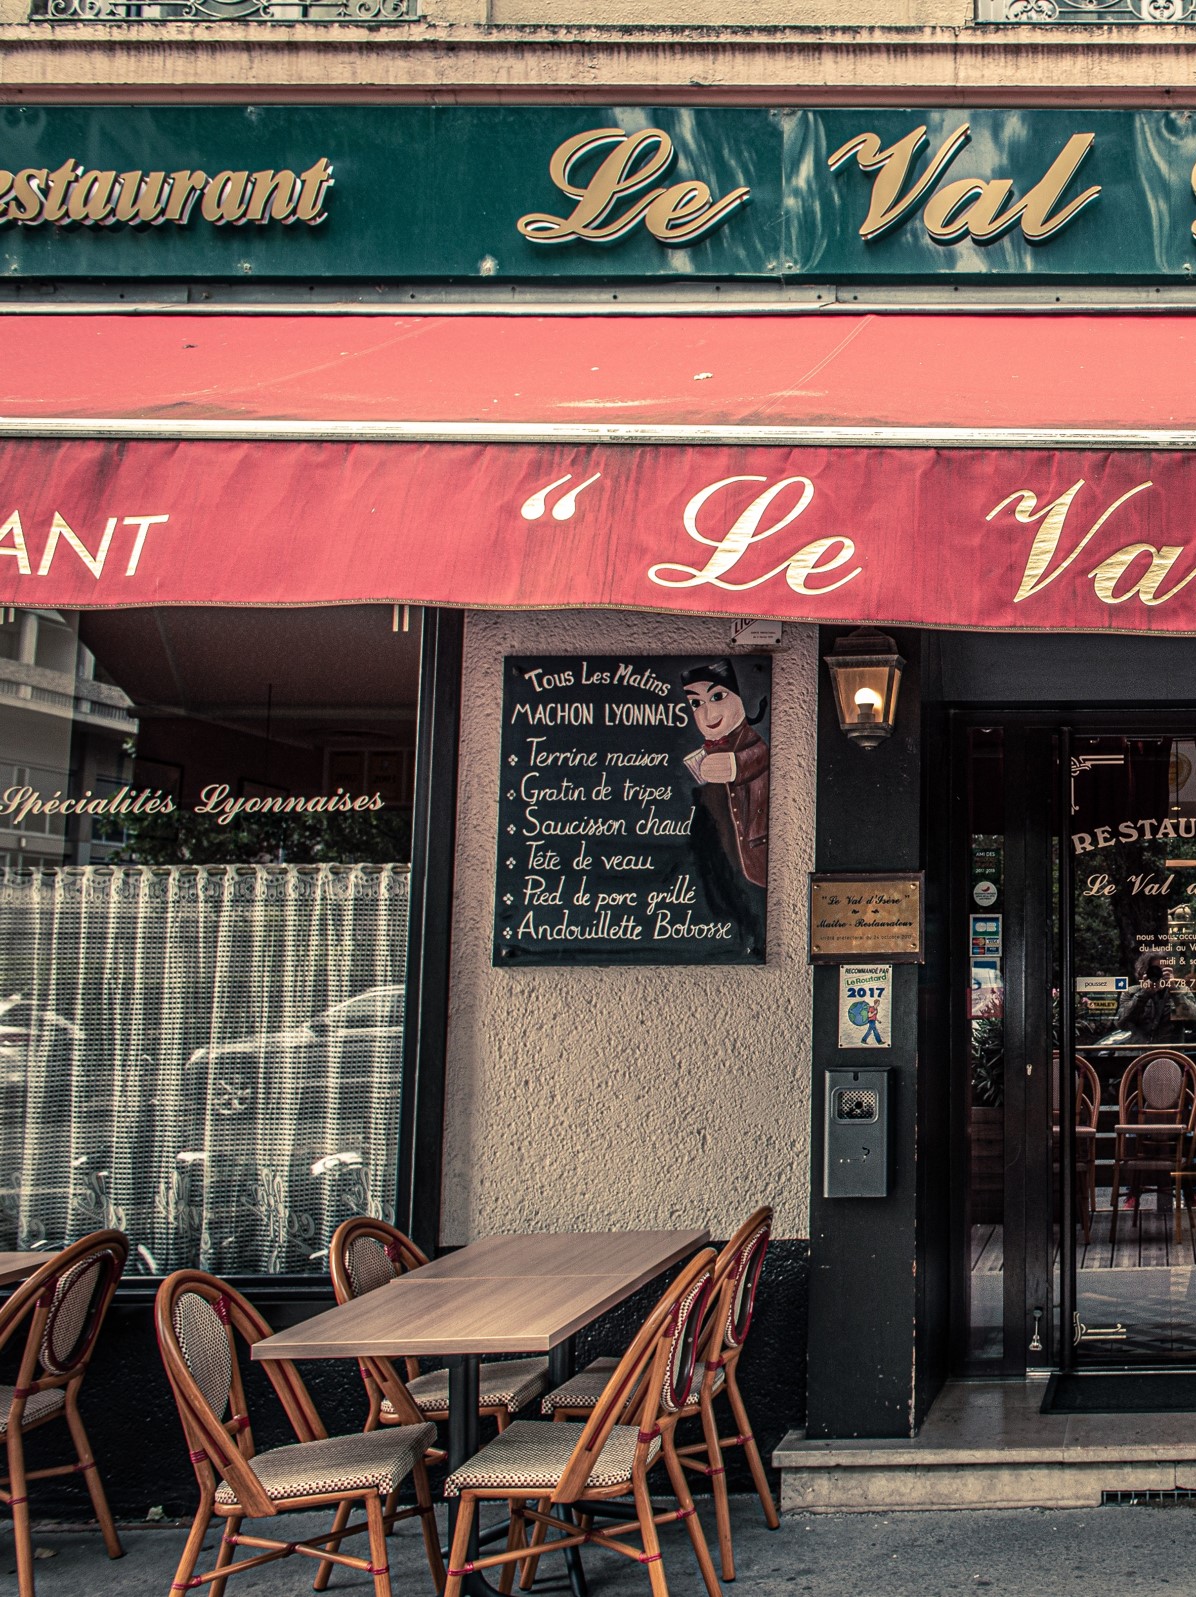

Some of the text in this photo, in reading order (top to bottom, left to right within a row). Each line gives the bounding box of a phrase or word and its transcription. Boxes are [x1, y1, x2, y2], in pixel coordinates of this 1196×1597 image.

[517, 128, 750, 246] Le
[828, 122, 1102, 242] Val
[647, 475, 862, 596] Le
[524, 662, 671, 696] Tous Les Matins
[511, 703, 688, 727] MACHON LYONNAIS
[526, 737, 669, 767] Terrine maison
[0, 783, 385, 825] Spécialités Lyonnaises
[521, 772, 672, 808] Gratin de tripes
[523, 806, 695, 836] Saucisson chaud
[526, 841, 655, 870] Tête de veau
[523, 875, 696, 915] Pied de porc grillé
[1083, 873, 1117, 896] Le
[1127, 872, 1176, 896] Val
[517, 910, 732, 940] Andouillette Bobosse
[1136, 933, 1155, 941] nous
[1139, 943, 1149, 952] du
[1151, 943, 1173, 952] Lundi
[1159, 957, 1176, 966] midi
[1179, 957, 1186, 965] &
[847, 987, 885, 998] 2017
[1159, 979, 1172, 988] 04
[1175, 978, 1187, 988] 78
